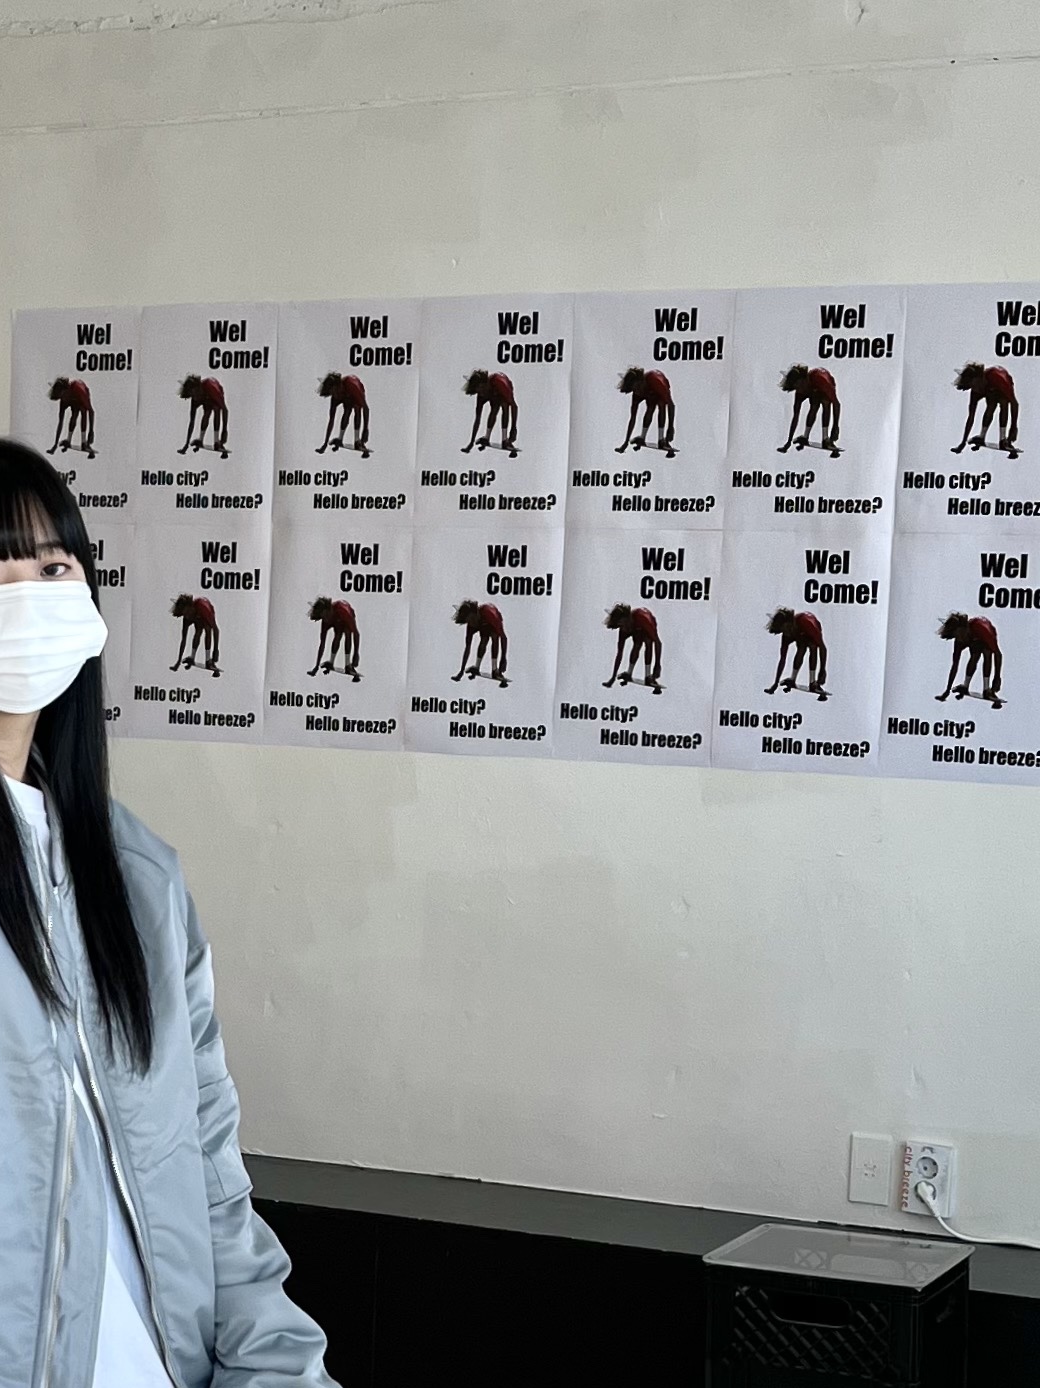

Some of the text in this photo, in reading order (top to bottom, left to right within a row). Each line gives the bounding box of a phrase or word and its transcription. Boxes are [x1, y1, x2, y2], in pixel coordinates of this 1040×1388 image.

[498, 312, 538, 335] Wel
[655, 308, 697, 332] Wel
[821, 304, 865, 329] Wel
[997, 301, 1040, 326] We
[77, 324, 111, 345] Wel
[210, 320, 246, 342] Wel
[350, 316, 388, 339] Wel
[350, 343, 412, 366] Come!
[497, 339, 564, 363] Come!
[654, 336, 724, 361] Come!
[819, 334, 894, 358] Come!
[76, 349, 132, 371] Come!
[209, 347, 269, 369] Come!
[141, 470, 208, 487] Hello city?
[279, 470, 348, 487] Hello city?
[421, 470, 495, 487] Hello city?
[573, 471, 651, 488] Hello city?
[732, 471, 815, 489] Hello city?
[903, 472, 991, 491] Hello city?
[79, 493, 128, 508] breeze?
[176, 493, 262, 508] Hello breeze?
[314, 494, 406, 509] Hello breeze?
[459, 494, 556, 510] Hello breeze?
[612, 495, 715, 512] Hello breeze?
[774, 496, 882, 513] Hello breeze?
[948, 498, 1040, 516] Hello breez
[90, 540, 104, 561] el
[202, 542, 237, 563] Wel
[341, 543, 379, 565] Wel
[488, 545, 527, 567] Wel
[642, 548, 684, 571] Wel
[806, 550, 850, 574] Wel
[981, 554, 1028, 578] Wel
[97, 566, 126, 587] me!
[201, 568, 260, 590] Come!
[340, 570, 402, 593] Come!
[487, 573, 553, 595] Come!
[641, 576, 711, 600] Come!
[805, 579, 878, 604] Come!
[134, 686, 200, 704] Hello city?
[270, 691, 339, 709] Hello city?
[411, 697, 485, 716] Hello city?
[560, 703, 638, 723] Hello city?
[169, 709, 255, 727] Hello breeze?
[306, 715, 396, 734] Hello breeze?
[720, 710, 802, 730] Hello city?
[888, 718, 975, 739] Hello city?
[450, 722, 546, 741] Hello breeze?
[600, 729, 702, 749] Hello breeze?
[762, 737, 870, 757] Hello breeze?
[932, 745, 975, 763] Hello
